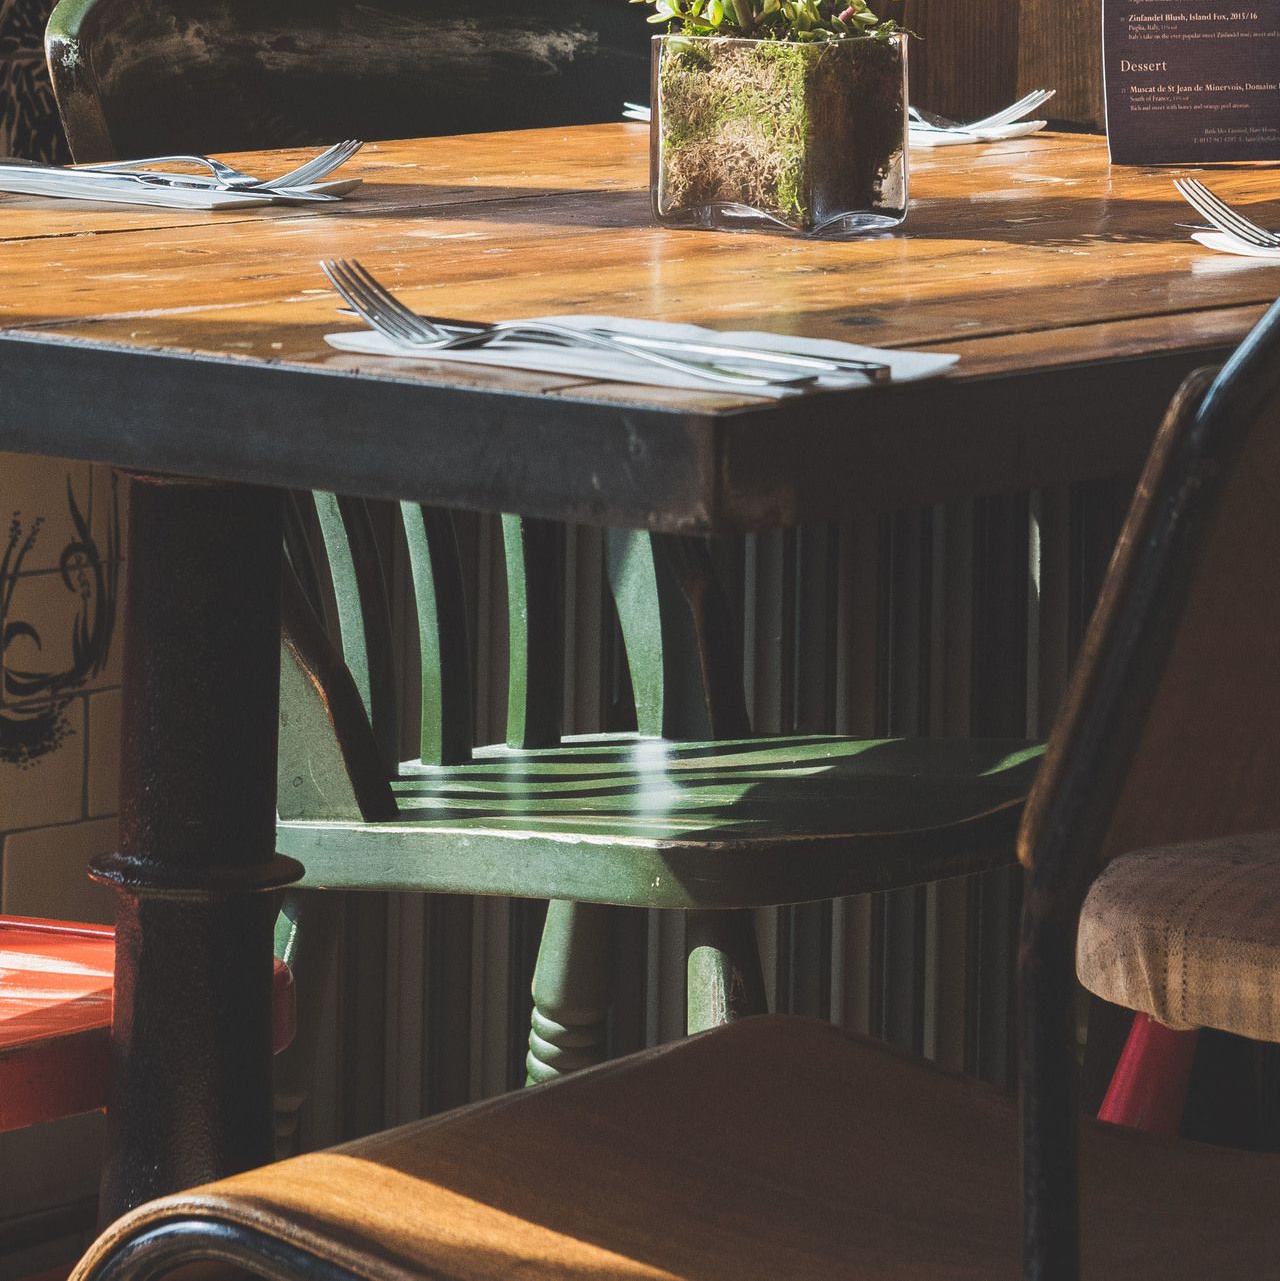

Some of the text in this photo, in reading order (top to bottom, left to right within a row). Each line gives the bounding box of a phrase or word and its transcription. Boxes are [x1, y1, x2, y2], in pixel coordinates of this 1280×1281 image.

[1128, 13, 1164, 21] Zinfandel
[1165, 13, 1188, 22] Blush,
[1213, 13, 1229, 21] Fox,
[1230, 12, 1258, 20] 2015/16
[1121, 60, 1168, 72] Dessert
[1130, 85, 1156, 93] Muscat
[1167, 84, 1175, 92] St
[1176, 84, 1192, 94] Jean
[1205, 83, 1244, 92] Minervois,
[1245, 82, 1277, 90] Domaine
